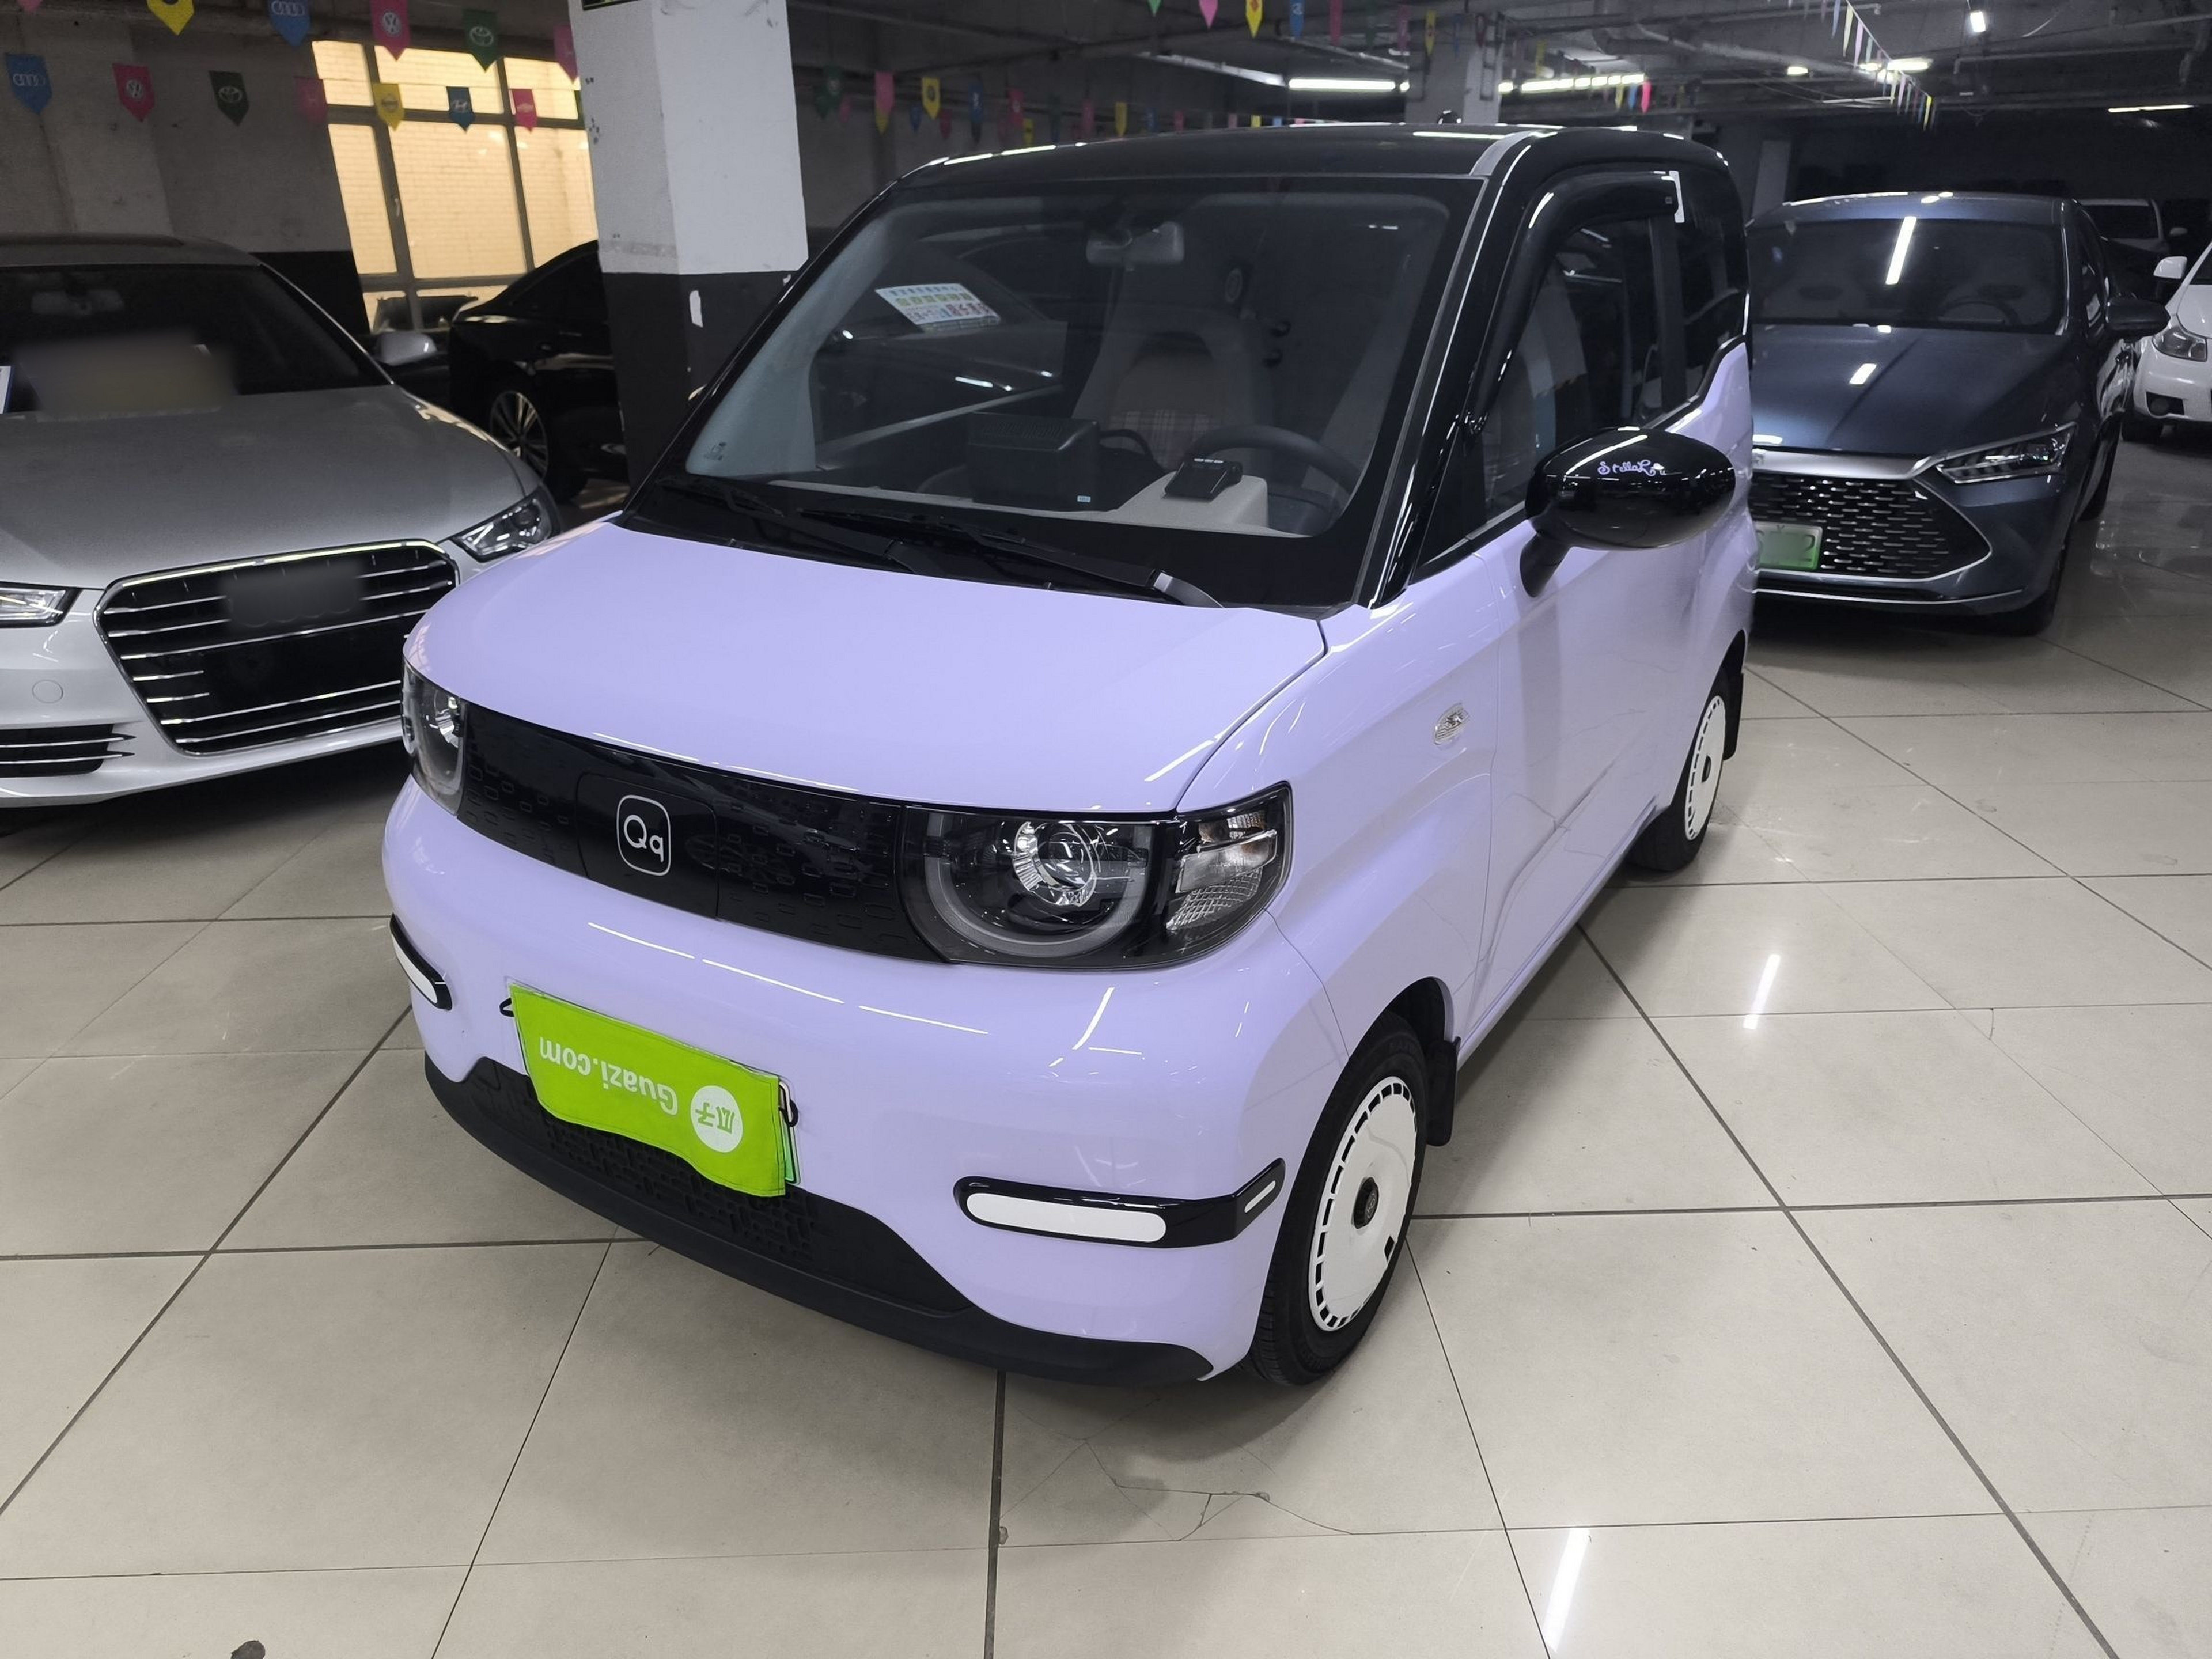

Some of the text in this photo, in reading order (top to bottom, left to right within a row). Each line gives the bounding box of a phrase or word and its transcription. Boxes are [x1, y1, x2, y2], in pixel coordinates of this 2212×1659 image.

[1597, 459, 1667, 477] StellaLu
[539, 1036, 735, 1135] 瓜子 Guazi.com
